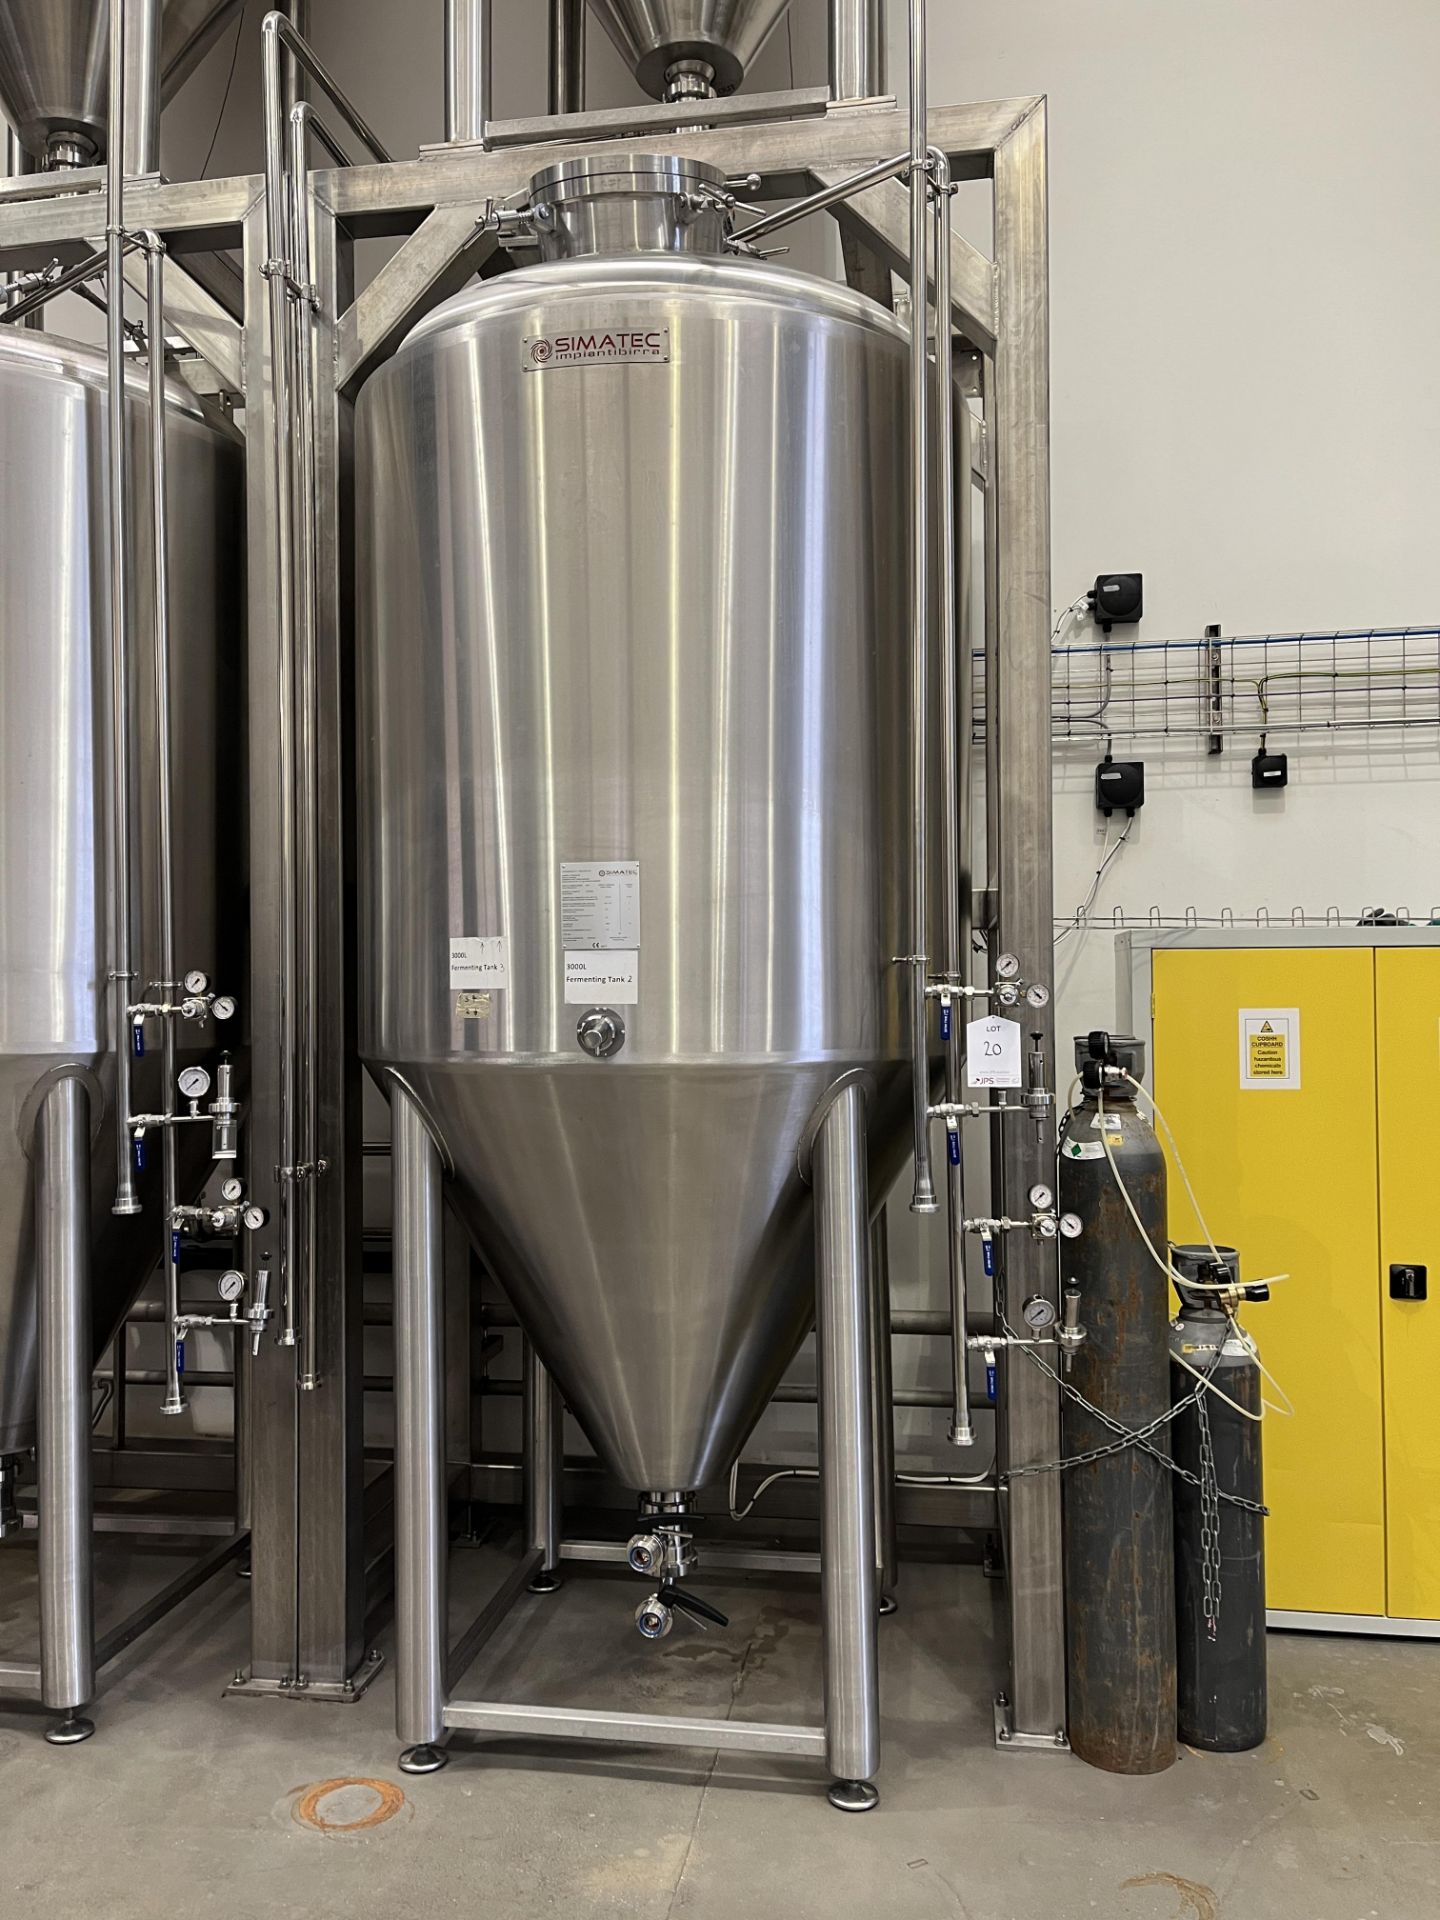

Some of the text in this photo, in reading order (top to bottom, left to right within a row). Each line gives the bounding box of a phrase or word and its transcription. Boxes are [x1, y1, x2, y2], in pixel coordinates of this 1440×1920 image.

[555, 333, 660, 353] SIMATEC
[556, 348, 660, 361] impiantibirra
[451, 964, 483, 972] Fermenting
[566, 975, 633, 985] Fermenting Tank 2
[983, 1041, 1002, 1056] 20
[980, 1077, 995, 1085] JPS
